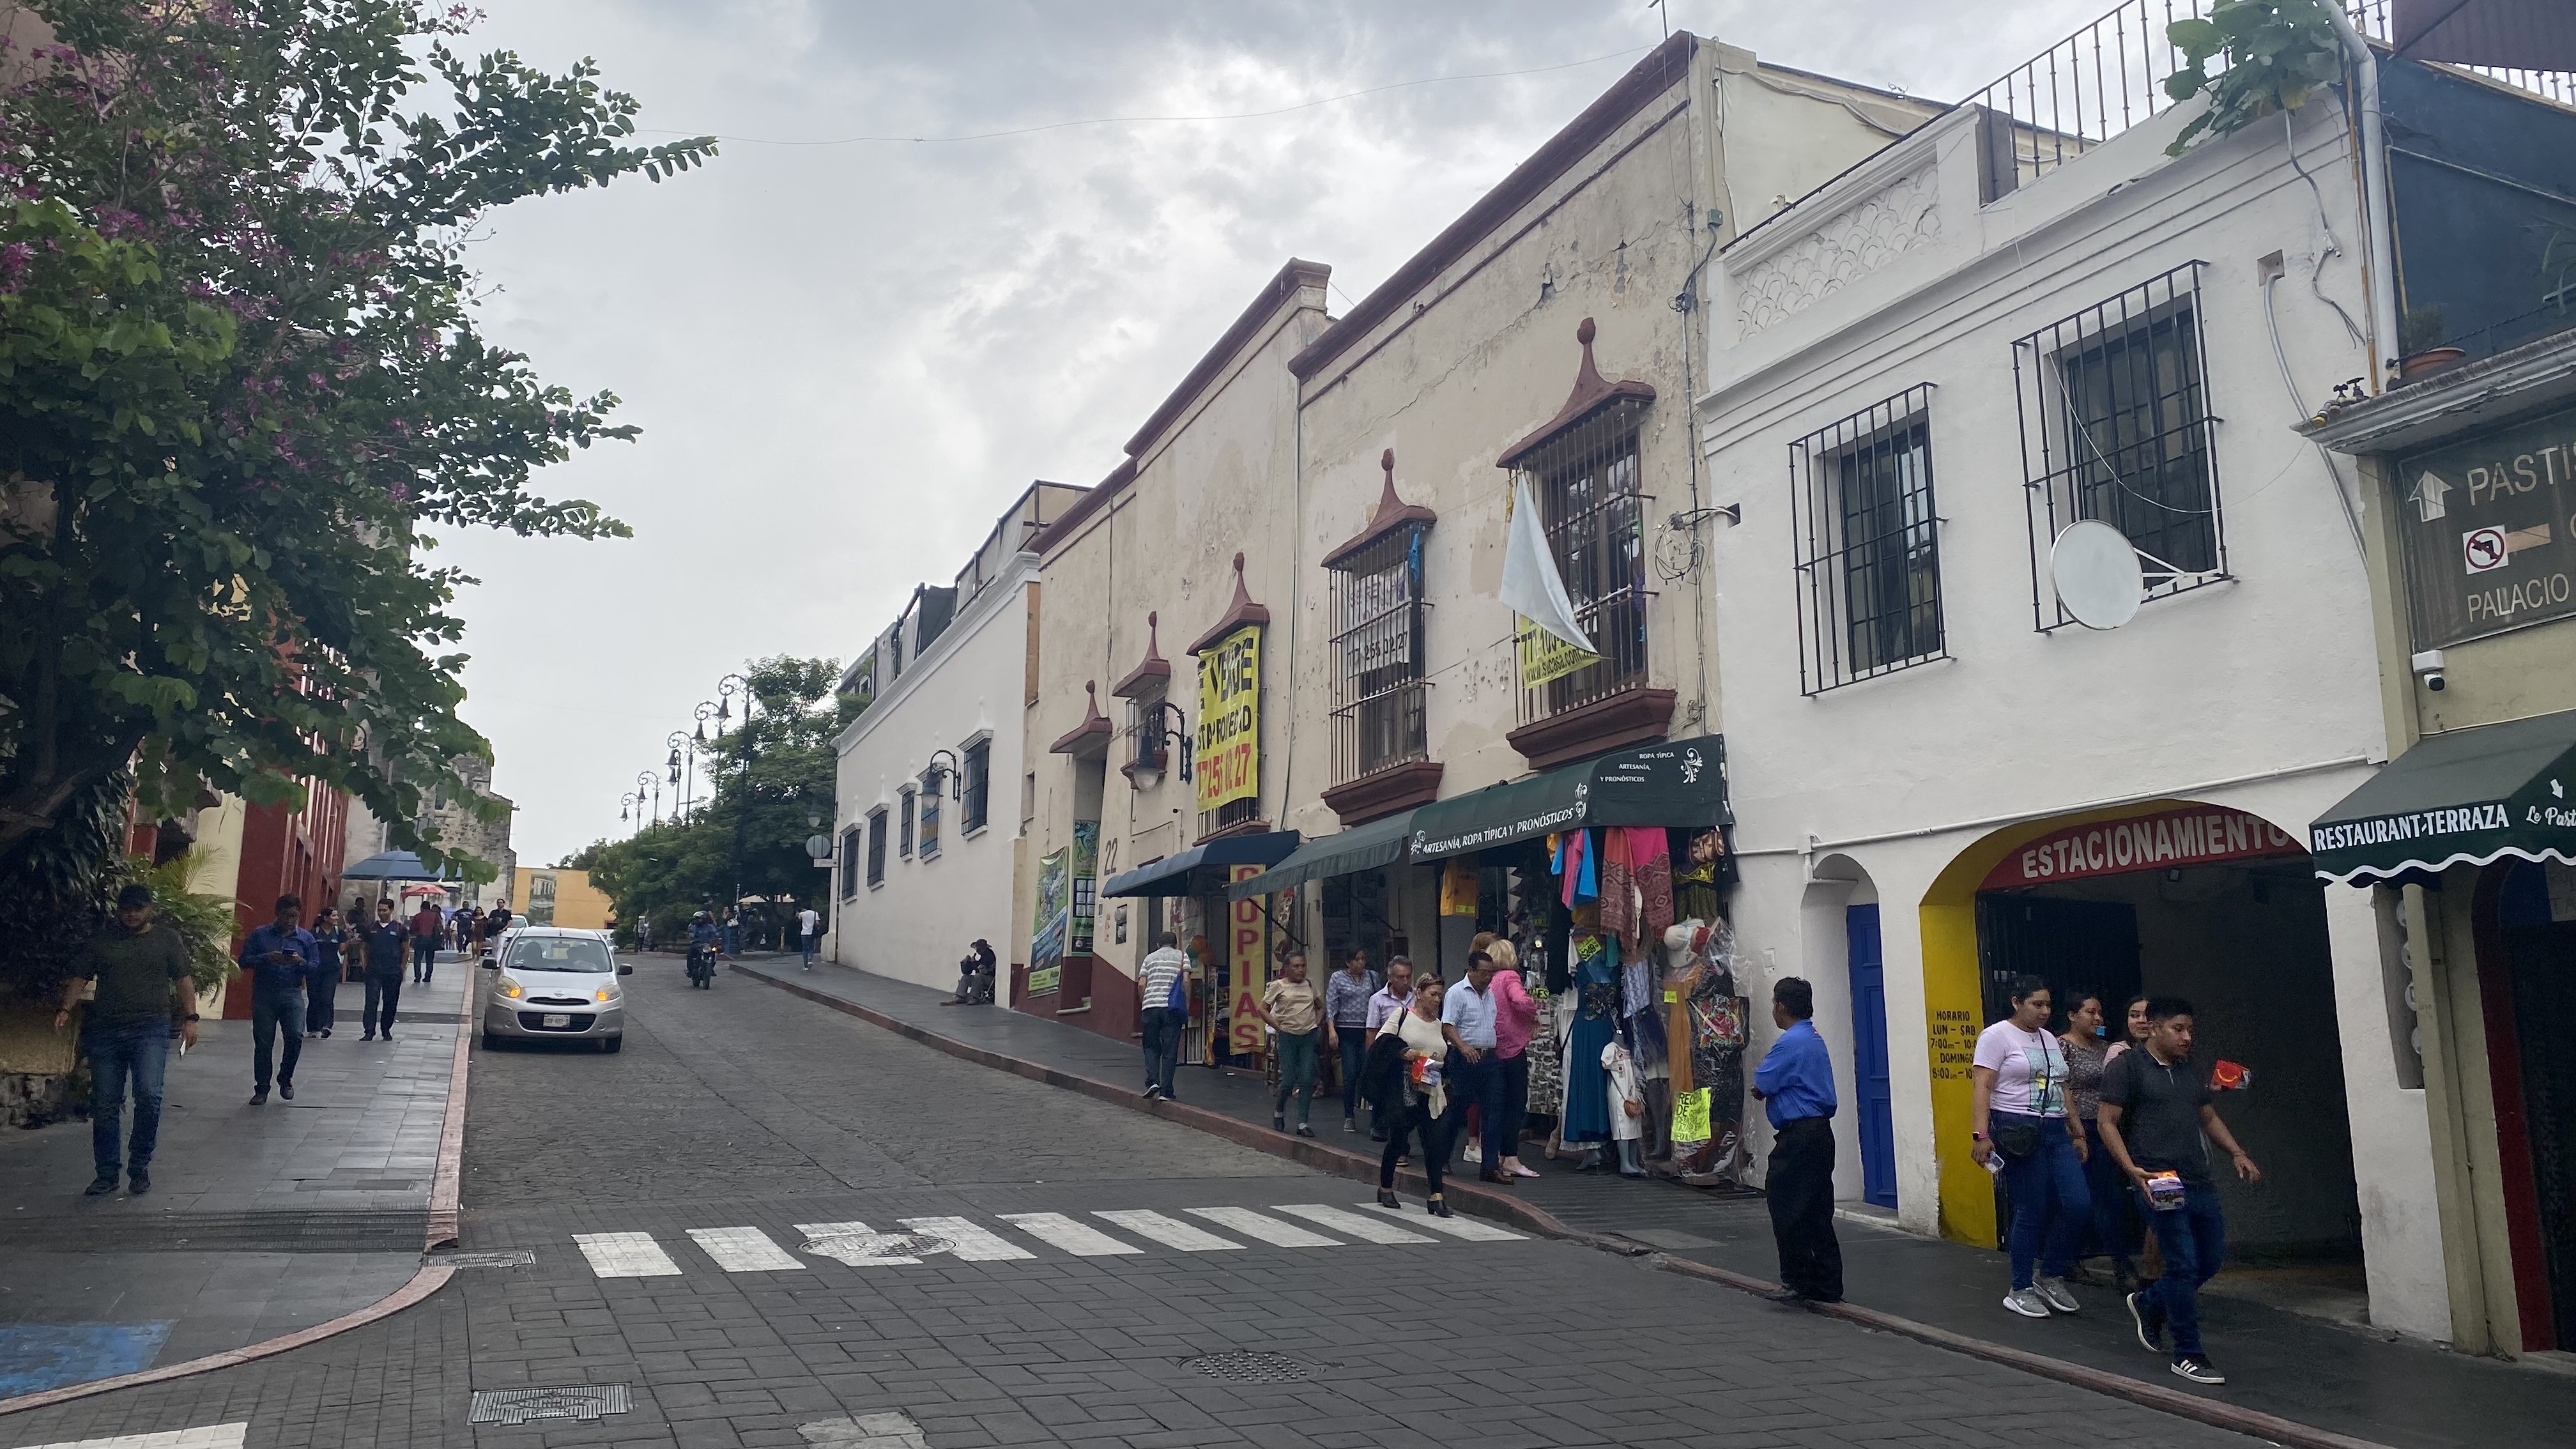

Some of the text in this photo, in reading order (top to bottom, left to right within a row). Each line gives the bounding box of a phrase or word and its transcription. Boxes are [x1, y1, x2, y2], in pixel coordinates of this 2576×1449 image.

[2467, 572, 2570, 624] PALACIO
[2526, 805, 2542, 824] Le
[1462, 832, 1483, 847] ROPA
[1483, 826, 1508, 842] TÍPICA
[1508, 825, 1514, 837] Y
[1517, 808, 1574, 834] PRONÓSTICOS
[2021, 813, 2290, 879] ESTACIONAMIENTO
[1104, 838, 1118, 876] 22
[1936, 1010, 1970, 1021] HORARIO
[1933, 1023, 1948, 1035] LUN
[1960, 1024, 1975, 1036] SAB
[1940, 1052, 1974, 1064] DOMINGO
[1676, 1104, 1690, 1117] DE
